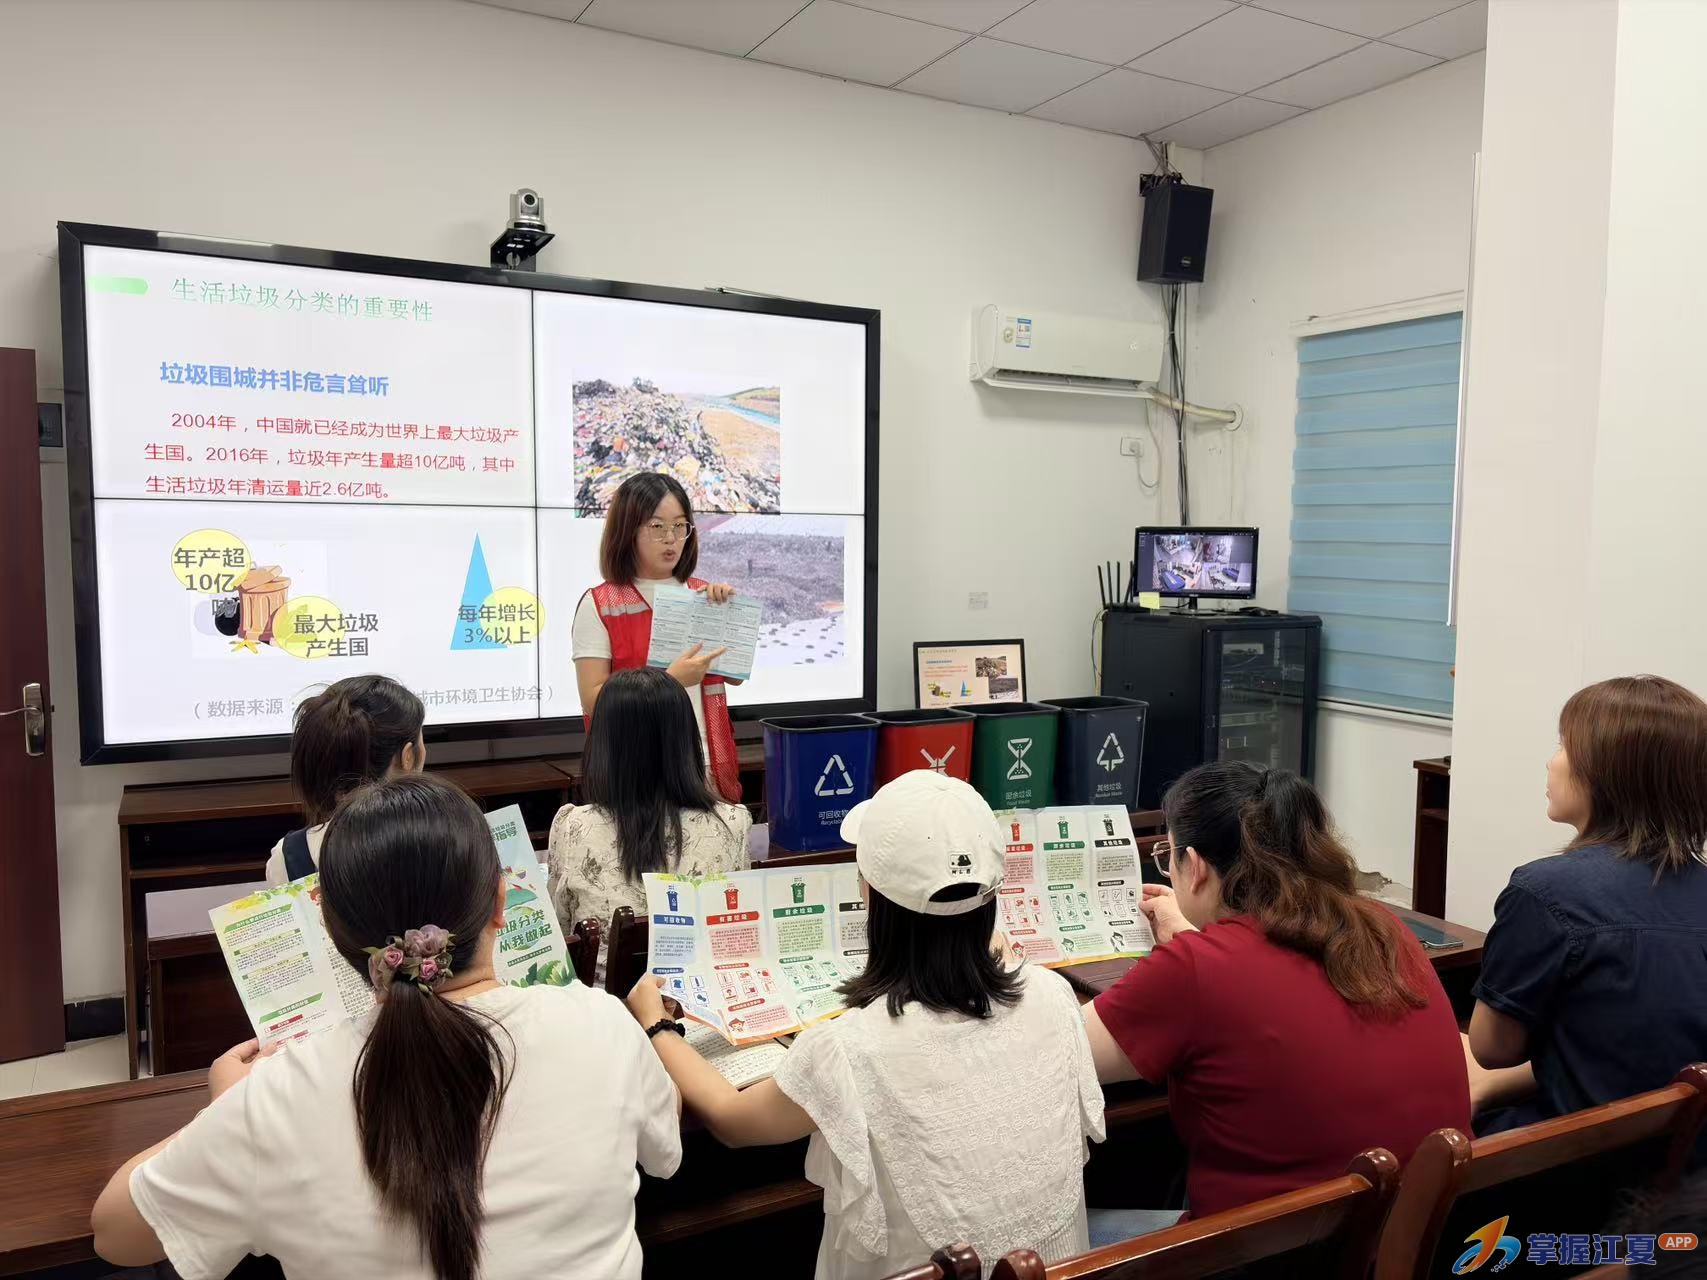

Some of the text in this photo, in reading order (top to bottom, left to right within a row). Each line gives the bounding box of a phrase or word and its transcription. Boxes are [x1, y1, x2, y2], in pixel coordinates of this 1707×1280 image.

[172, 277, 433, 322] 生活垃圾分类的重要性
[159, 361, 390, 397] 垃圾围城并非危言耸听
[171, 412, 519, 444] 2004年，中国就已经成为世界上最大垃圾产
[144, 442, 516, 474] 生国。2016年，垃圾年产生量超10亿吨，其中
[145, 474, 390, 499] 生活垃圾年清运量近2.6亿吨。
[174, 547, 245, 569] 年产超
[185, 573, 237, 594] 10亿
[293, 613, 379, 635] 最大垃圾
[458, 603, 535, 623] 每年增长
[463, 626, 532, 645] 3%以上
[305, 637, 369, 658] 产生国
